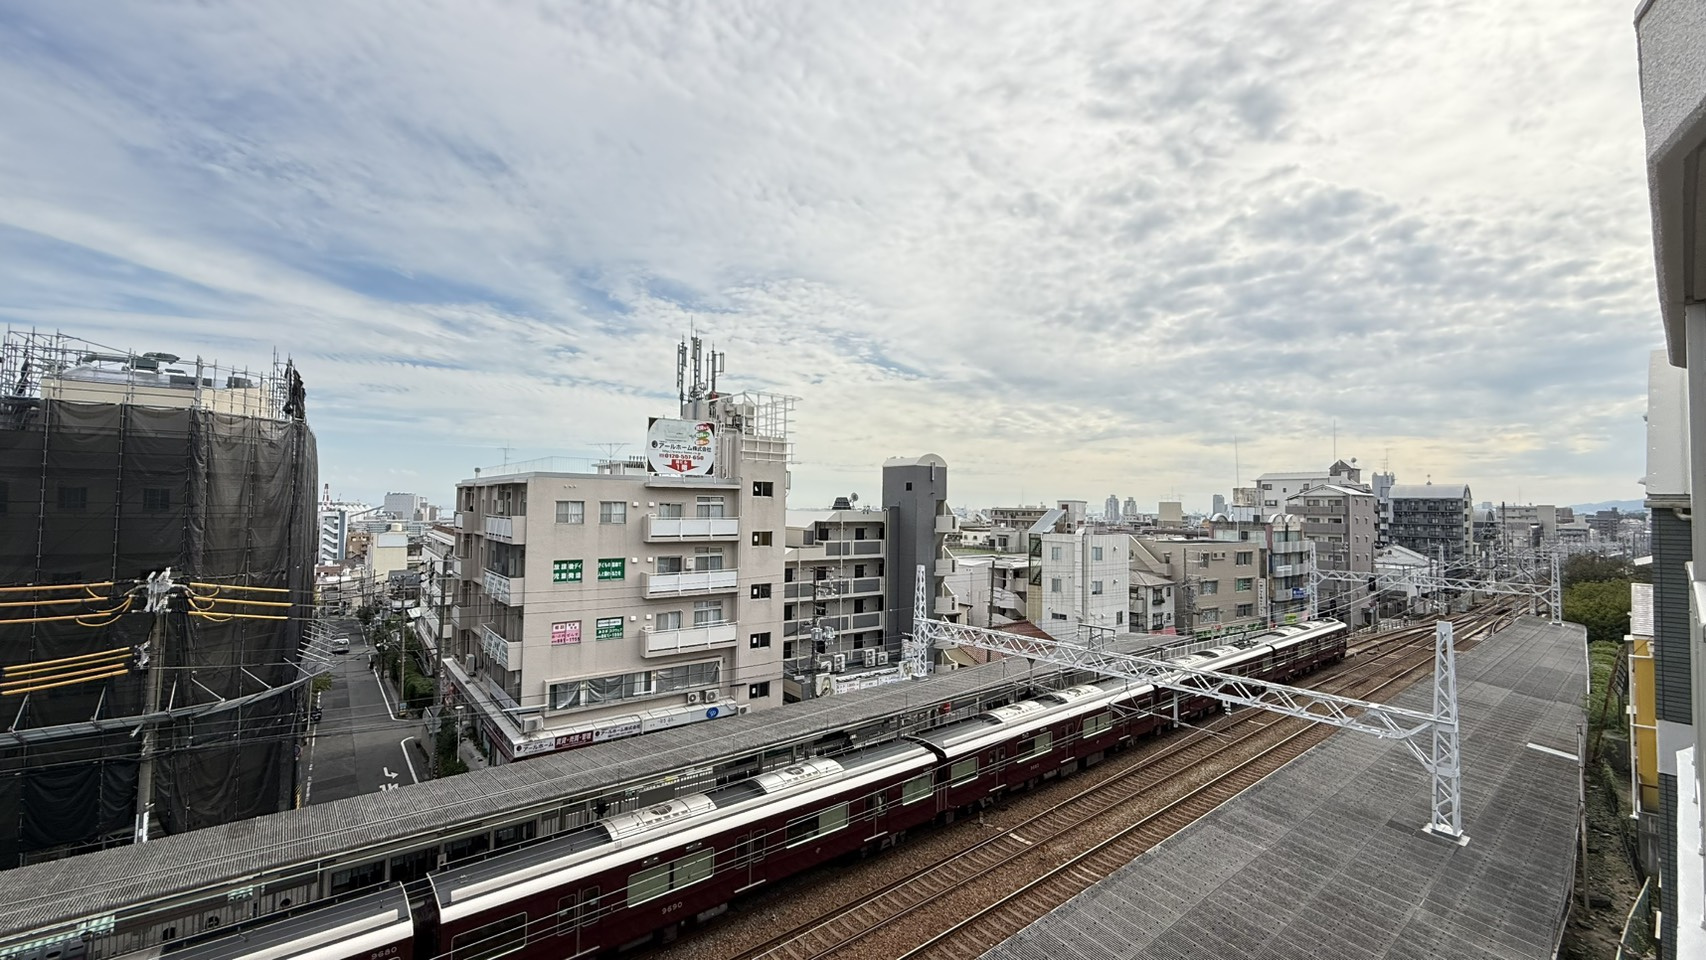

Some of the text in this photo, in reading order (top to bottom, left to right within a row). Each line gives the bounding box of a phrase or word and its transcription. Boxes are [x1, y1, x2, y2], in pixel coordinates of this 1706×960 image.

[659, 443, 712, 453] アールホーム株式会社
[523, 741, 554, 752] アールホーム
[661, 901, 683, 915] 9690
[371, 946, 398, 960] 9680
